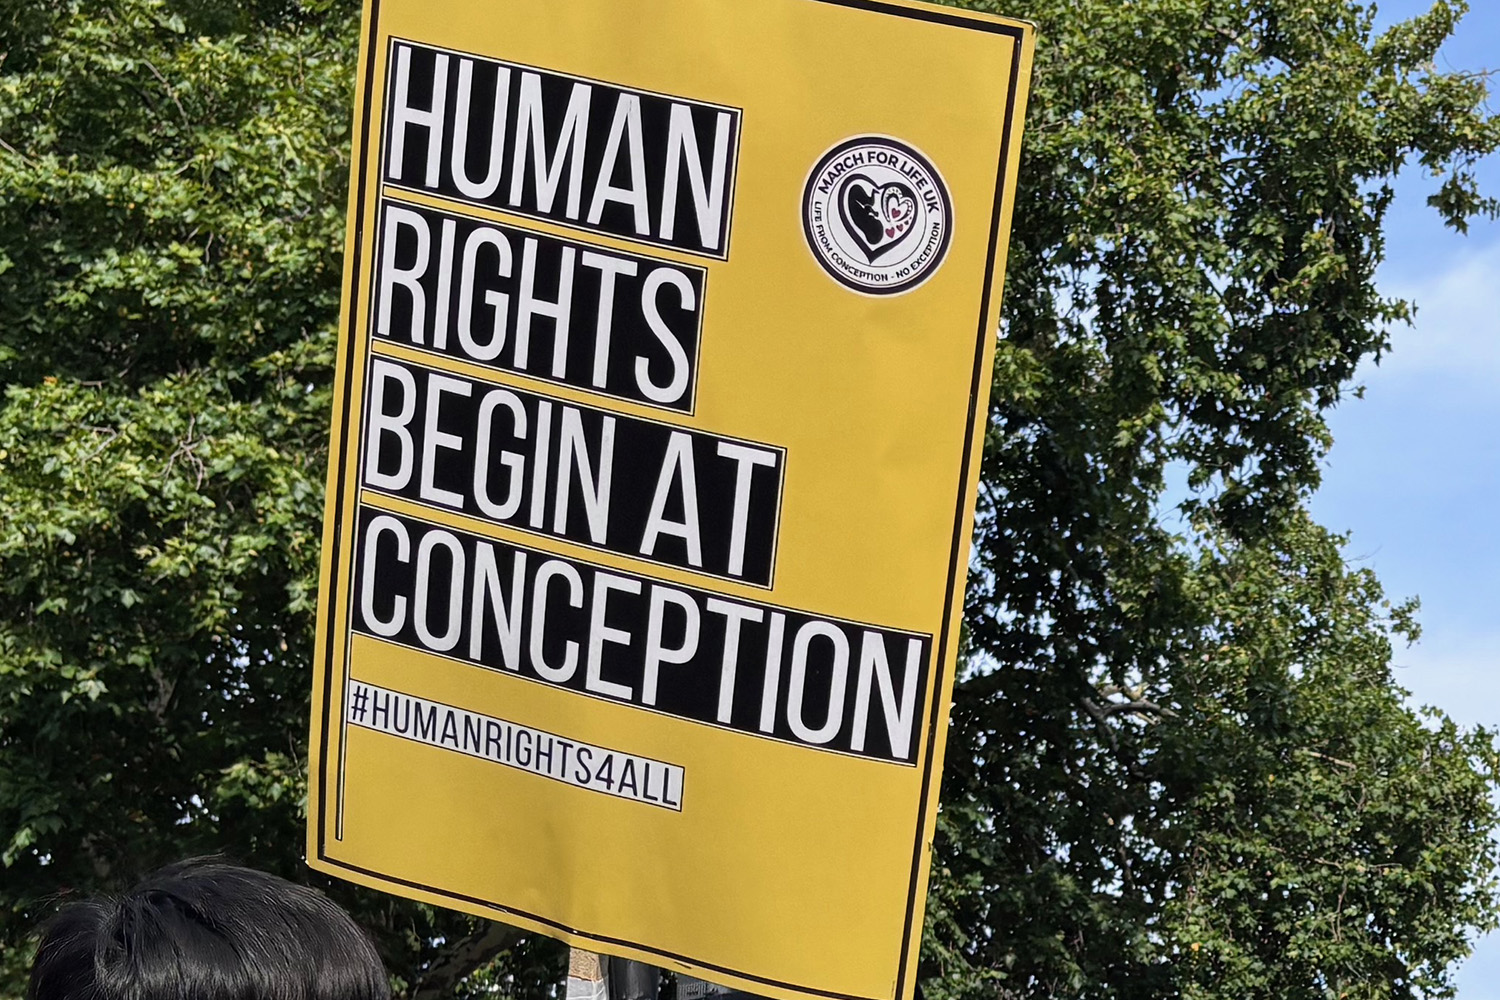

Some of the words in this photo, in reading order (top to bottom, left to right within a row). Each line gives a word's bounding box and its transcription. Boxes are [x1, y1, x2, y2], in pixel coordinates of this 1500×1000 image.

[388, 45, 732, 249] HUMAN
[814, 201, 822, 222] LIFE
[818, 152, 864, 194] MARCH
[867, 151, 899, 168] FOR
[900, 160, 928, 190] LIFE
[923, 189, 940, 214] UK
[816, 224, 832, 253] FROM
[831, 252, 888, 281] CONCEPTION
[910, 222, 940, 270] EXCEPTION
[895, 267, 910, 279] NO
[376, 205, 697, 405] RIGHTS
[363, 359, 617, 547] BEGIN
[639, 431, 777, 577] AT
[360, 514, 923, 761] CONCEPTION
[350, 684, 679, 808] #HUMANRIGHTS4ALL
